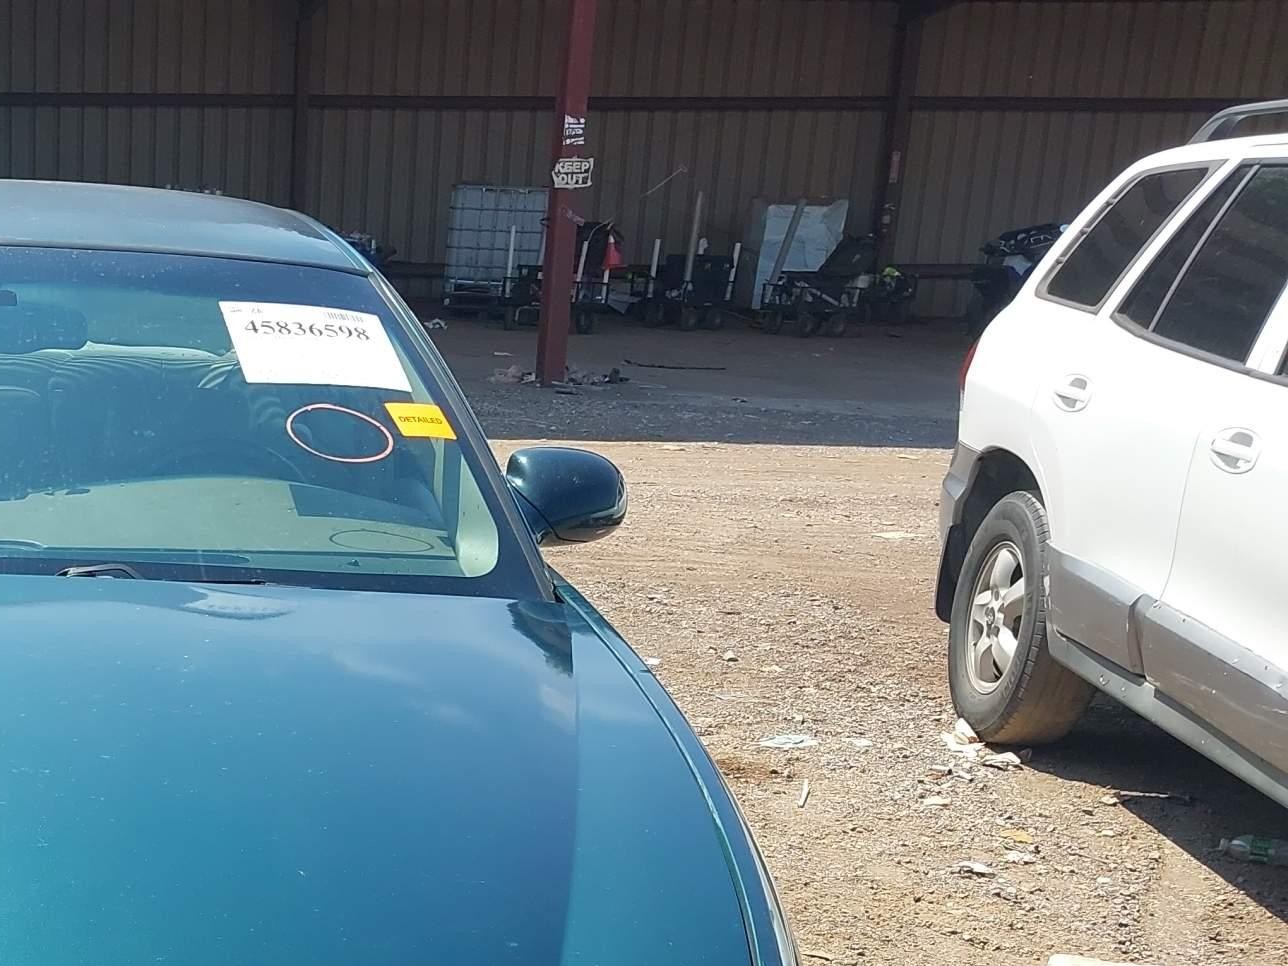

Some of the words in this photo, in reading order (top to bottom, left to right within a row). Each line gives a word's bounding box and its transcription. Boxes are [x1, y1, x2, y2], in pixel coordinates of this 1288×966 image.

[555, 161, 590, 173] KEEP
[558, 173, 589, 185] OUT
[244, 319, 371, 341] 45836598
[398, 416, 443, 425] DETAILED
